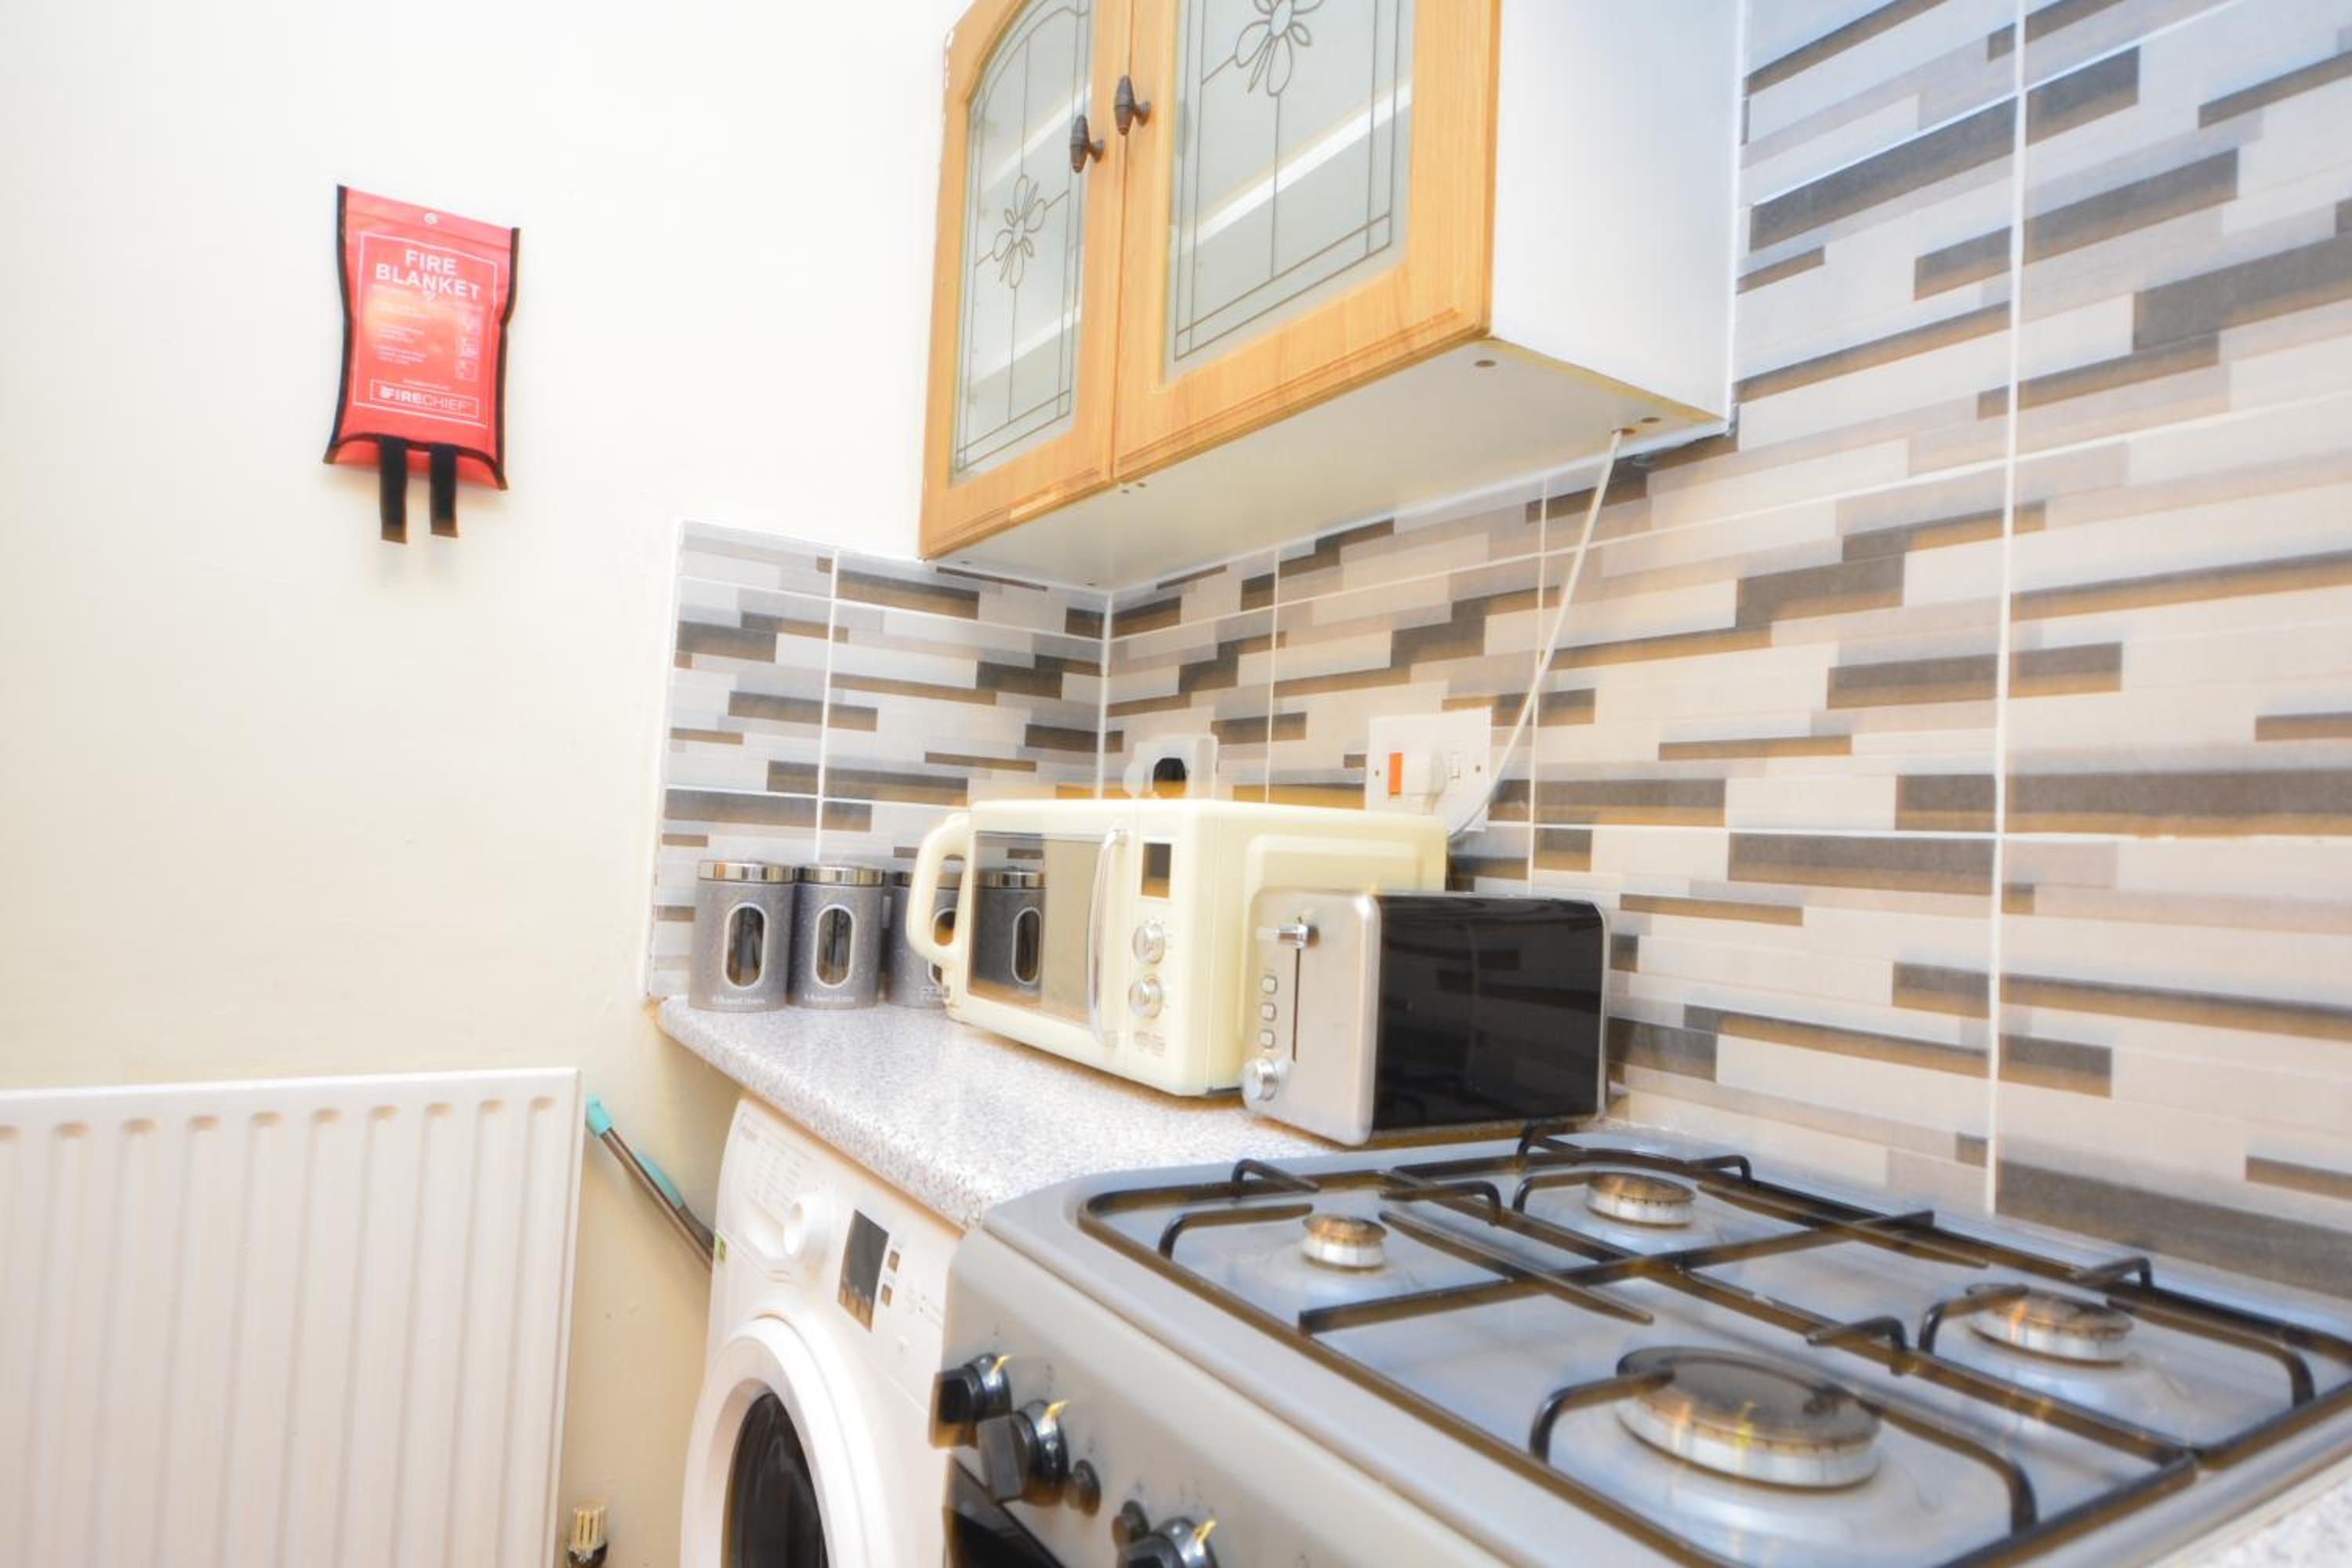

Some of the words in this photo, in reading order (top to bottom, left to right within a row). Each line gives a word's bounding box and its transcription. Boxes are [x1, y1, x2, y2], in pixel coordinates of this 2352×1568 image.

[405, 249, 457, 275] FIRE
[376, 263, 480, 300] BLANKET
[381, 387, 468, 412] FIRECHIEF
